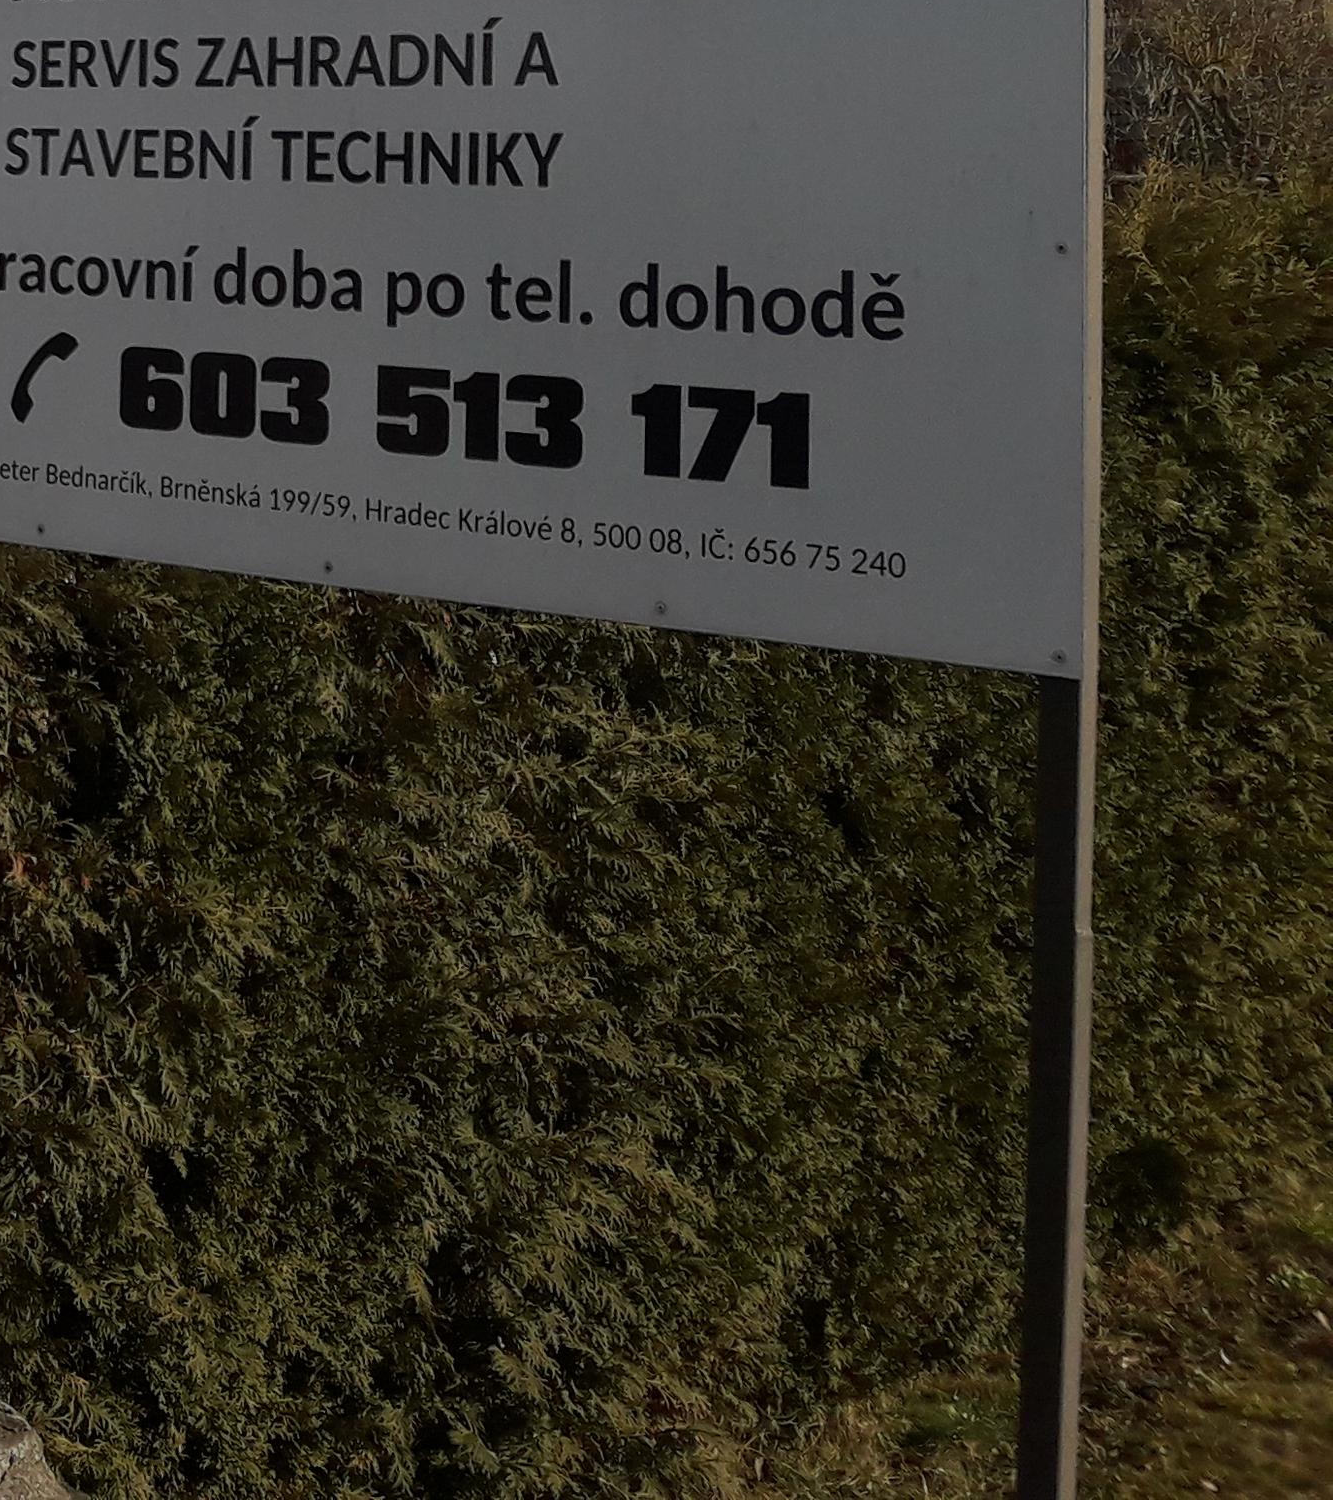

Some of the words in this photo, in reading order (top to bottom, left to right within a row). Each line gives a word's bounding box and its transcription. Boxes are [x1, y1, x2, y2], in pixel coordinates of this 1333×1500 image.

[10, 37, 180, 89] SERVIS
[194, 16, 504, 89] ZAHRADNÍ
[512, 30, 560, 87] A
[3, 114, 261, 182] STAVEBNÍ
[270, 129, 565, 189] TECHNIKY
[212, 245, 363, 313] doba
[386, 270, 466, 329] po
[484, 258, 594, 326] tel.
[618, 261, 906, 342] dohodě
[118, 345, 331, 446] 603
[375, 363, 585, 470] 513
[630, 382, 811, 491] 171
[45, 462, 153, 500] Bednarčík,
[159, 475, 261, 509] Brněnská
[269, 487, 357, 523] 199/59,
[365, 497, 451, 530] Hradec
[458, 507, 553, 541] Králové
[560, 516, 583, 549] 8,
[592, 521, 642, 551] 500
[648, 527, 691, 561] 08,
[700, 527, 734, 561] IČ:
[744, 535, 797, 568] 656
[805, 543, 841, 572] 75
[850, 547, 907, 579] 240
